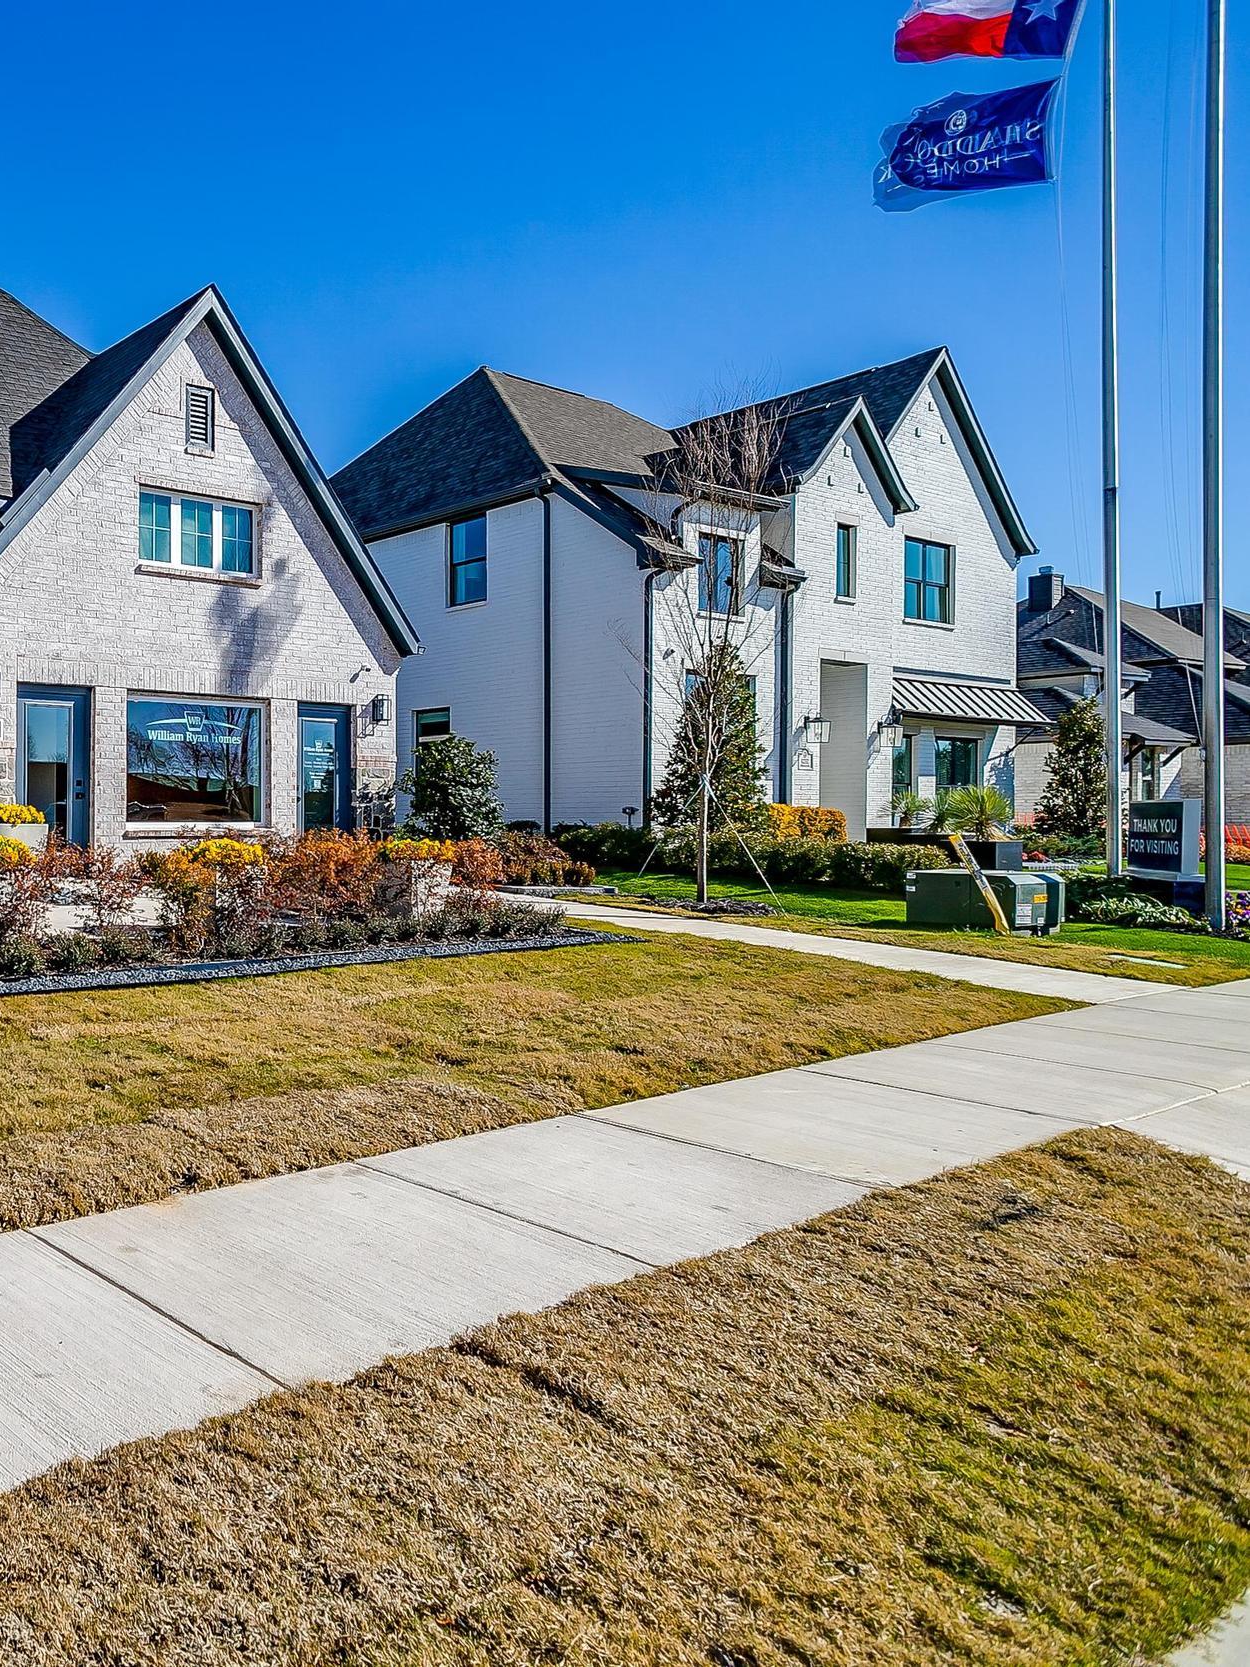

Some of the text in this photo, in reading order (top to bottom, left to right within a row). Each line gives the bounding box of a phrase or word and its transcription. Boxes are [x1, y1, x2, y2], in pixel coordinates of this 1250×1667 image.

[187, 715, 201, 725] WR
[147, 729, 242, 744] William Ryan Homes
[1133, 818, 1177, 833] THANK YOU
[1130, 839, 1179, 855] FOR VISITING
